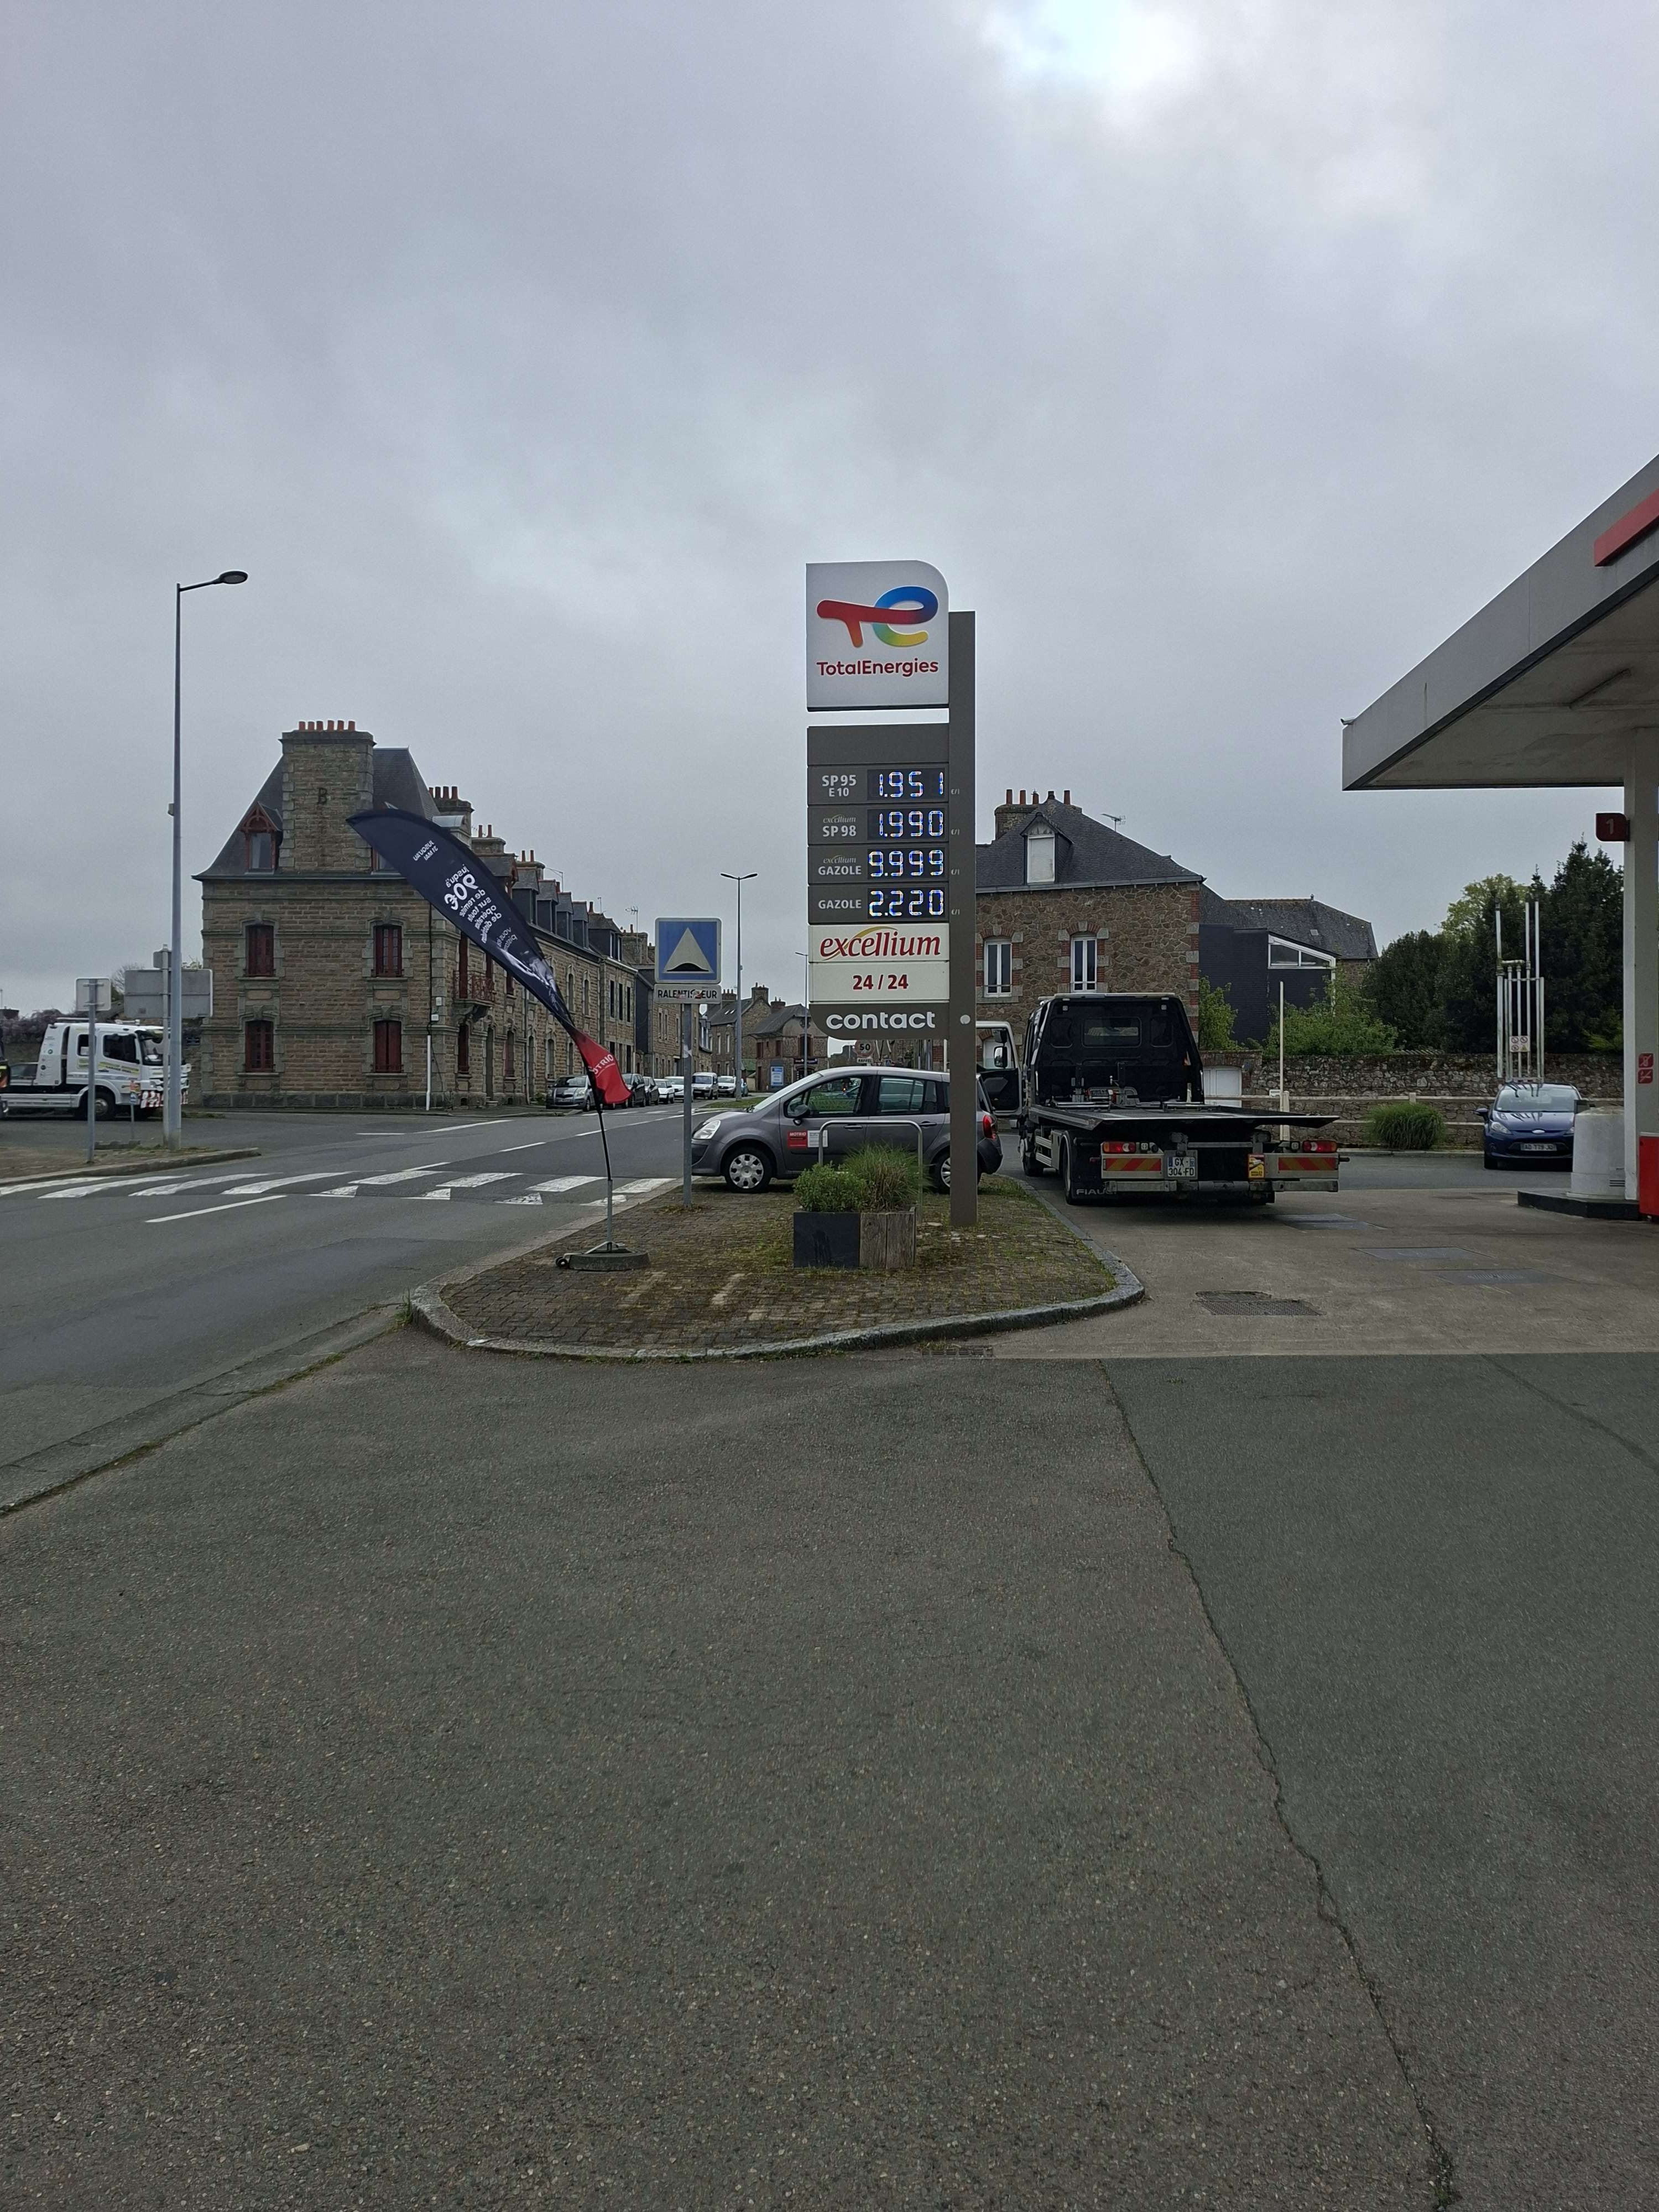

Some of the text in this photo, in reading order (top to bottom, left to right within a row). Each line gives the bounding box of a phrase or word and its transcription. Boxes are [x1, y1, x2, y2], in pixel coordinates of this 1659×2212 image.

[817, 658, 938, 677] TotalEnergies
[879, 771, 943, 797] 1.951
[823, 815, 856, 823] excellium
[879, 811, 943, 837] 1.990
[1605, 818, 1614, 835] 1
[823, 855, 856, 864] excellium
[868, 849, 943, 877] 9.999
[818, 865, 862, 876] GAZOLE
[818, 899, 862, 910] GAZOLE
[869, 889, 943, 916] 2.220
[820, 930, 941, 958] excellium
[658, 989, 717, 999] RALENTISEUR
[826, 1011, 935, 1029] contact
[859, 1043, 870, 1051] 50
